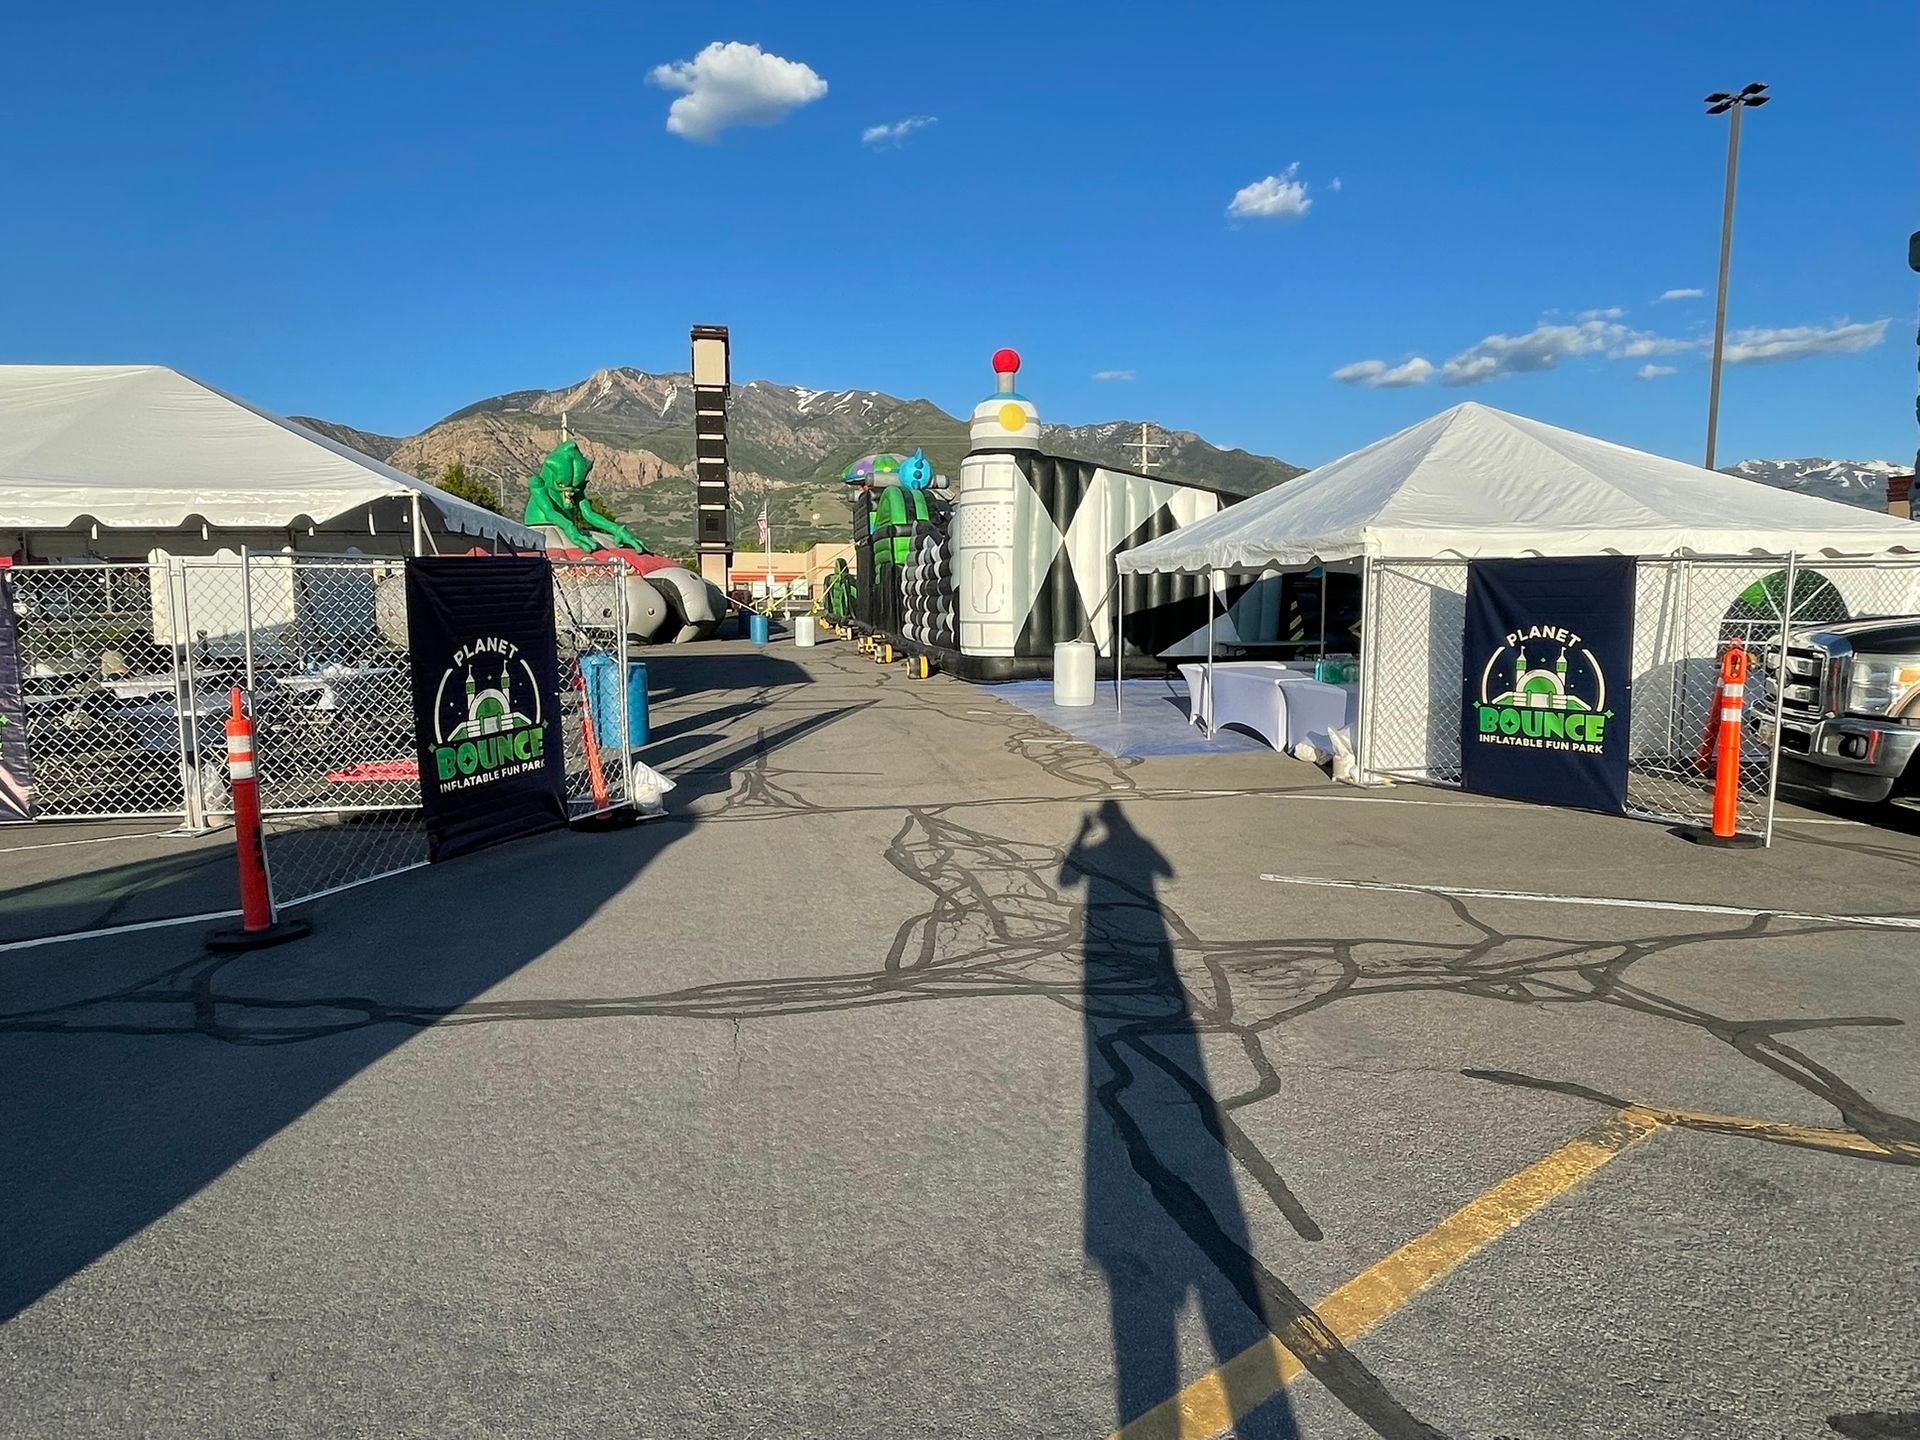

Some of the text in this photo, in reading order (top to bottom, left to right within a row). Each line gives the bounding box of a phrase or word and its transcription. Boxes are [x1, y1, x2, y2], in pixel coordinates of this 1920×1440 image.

[1506, 625, 1582, 647] PLANET
[453, 637, 518, 667] PLANET
[1479, 706, 1606, 742] BOUNCE
[435, 727, 544, 781] BOUNCE
[1479, 734, 1604, 754] INFLATABLE FUN PARK
[440, 769, 500, 794] INFLATABLE
[501, 765, 520, 778] FUN
